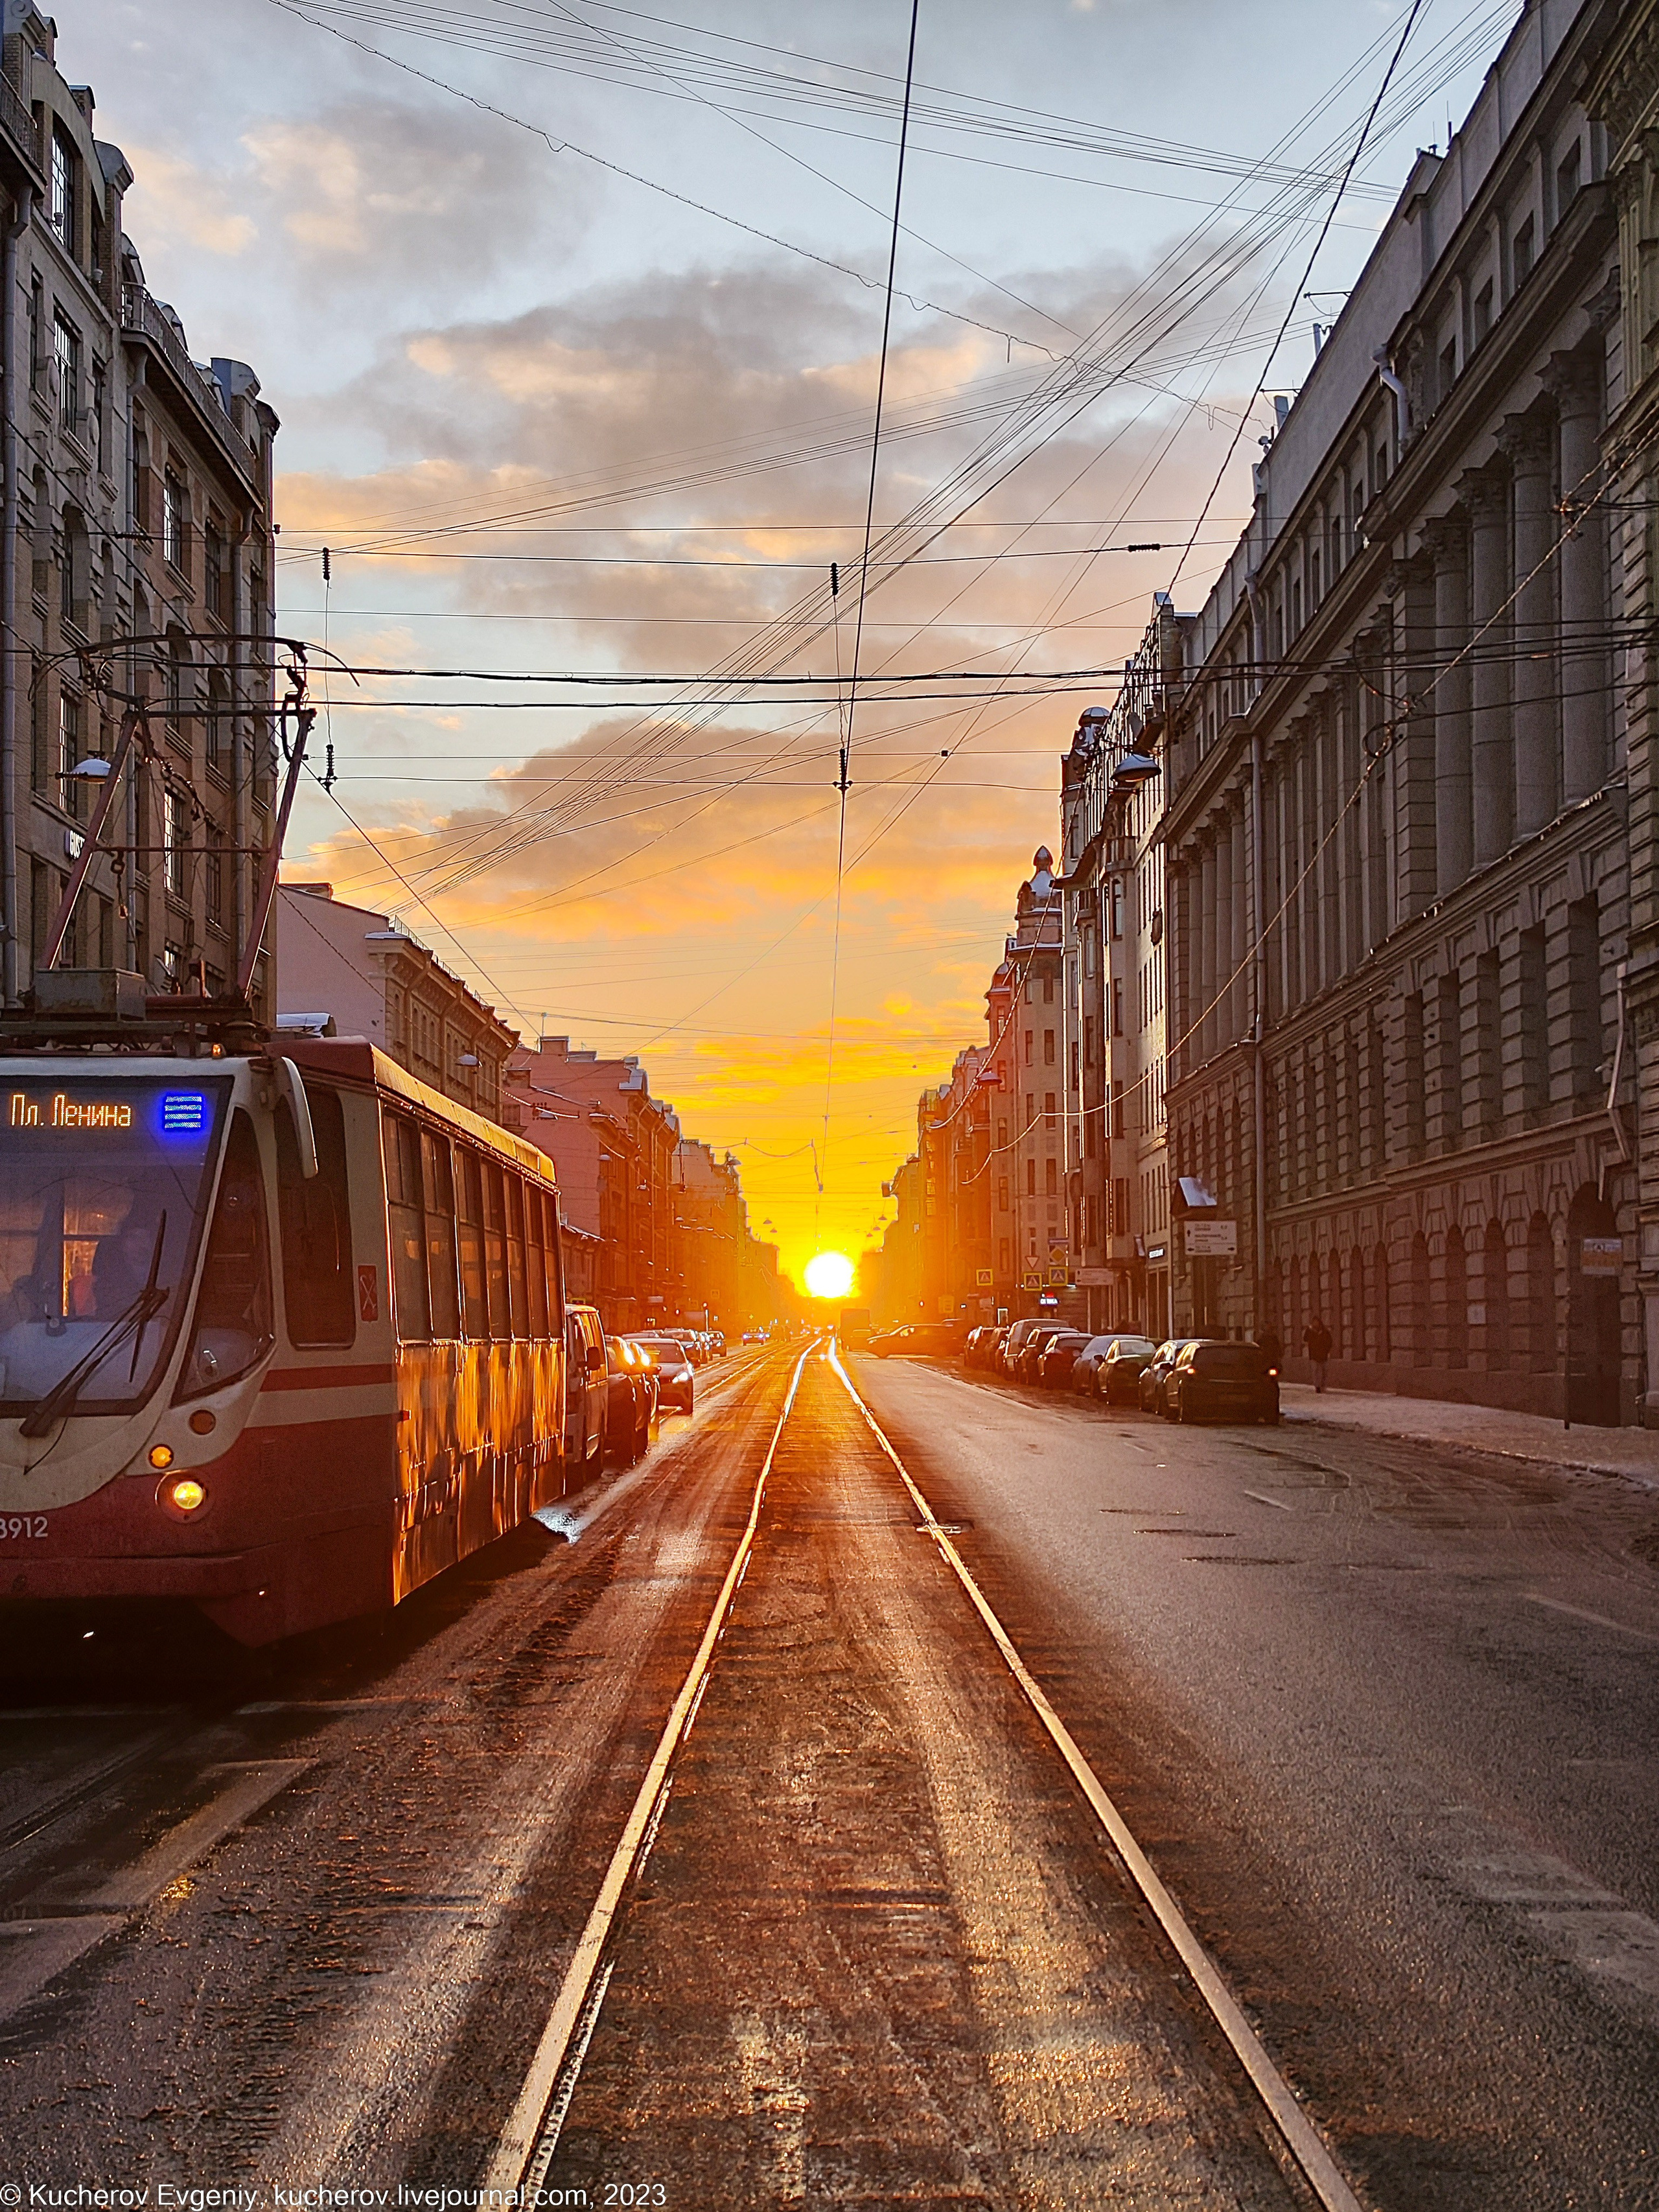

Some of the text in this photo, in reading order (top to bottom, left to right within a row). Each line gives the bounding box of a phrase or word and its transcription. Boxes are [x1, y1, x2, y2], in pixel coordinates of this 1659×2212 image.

[69, 830, 86, 858] GUST
[12, 1095, 131, 1126] Пл. Ленина
